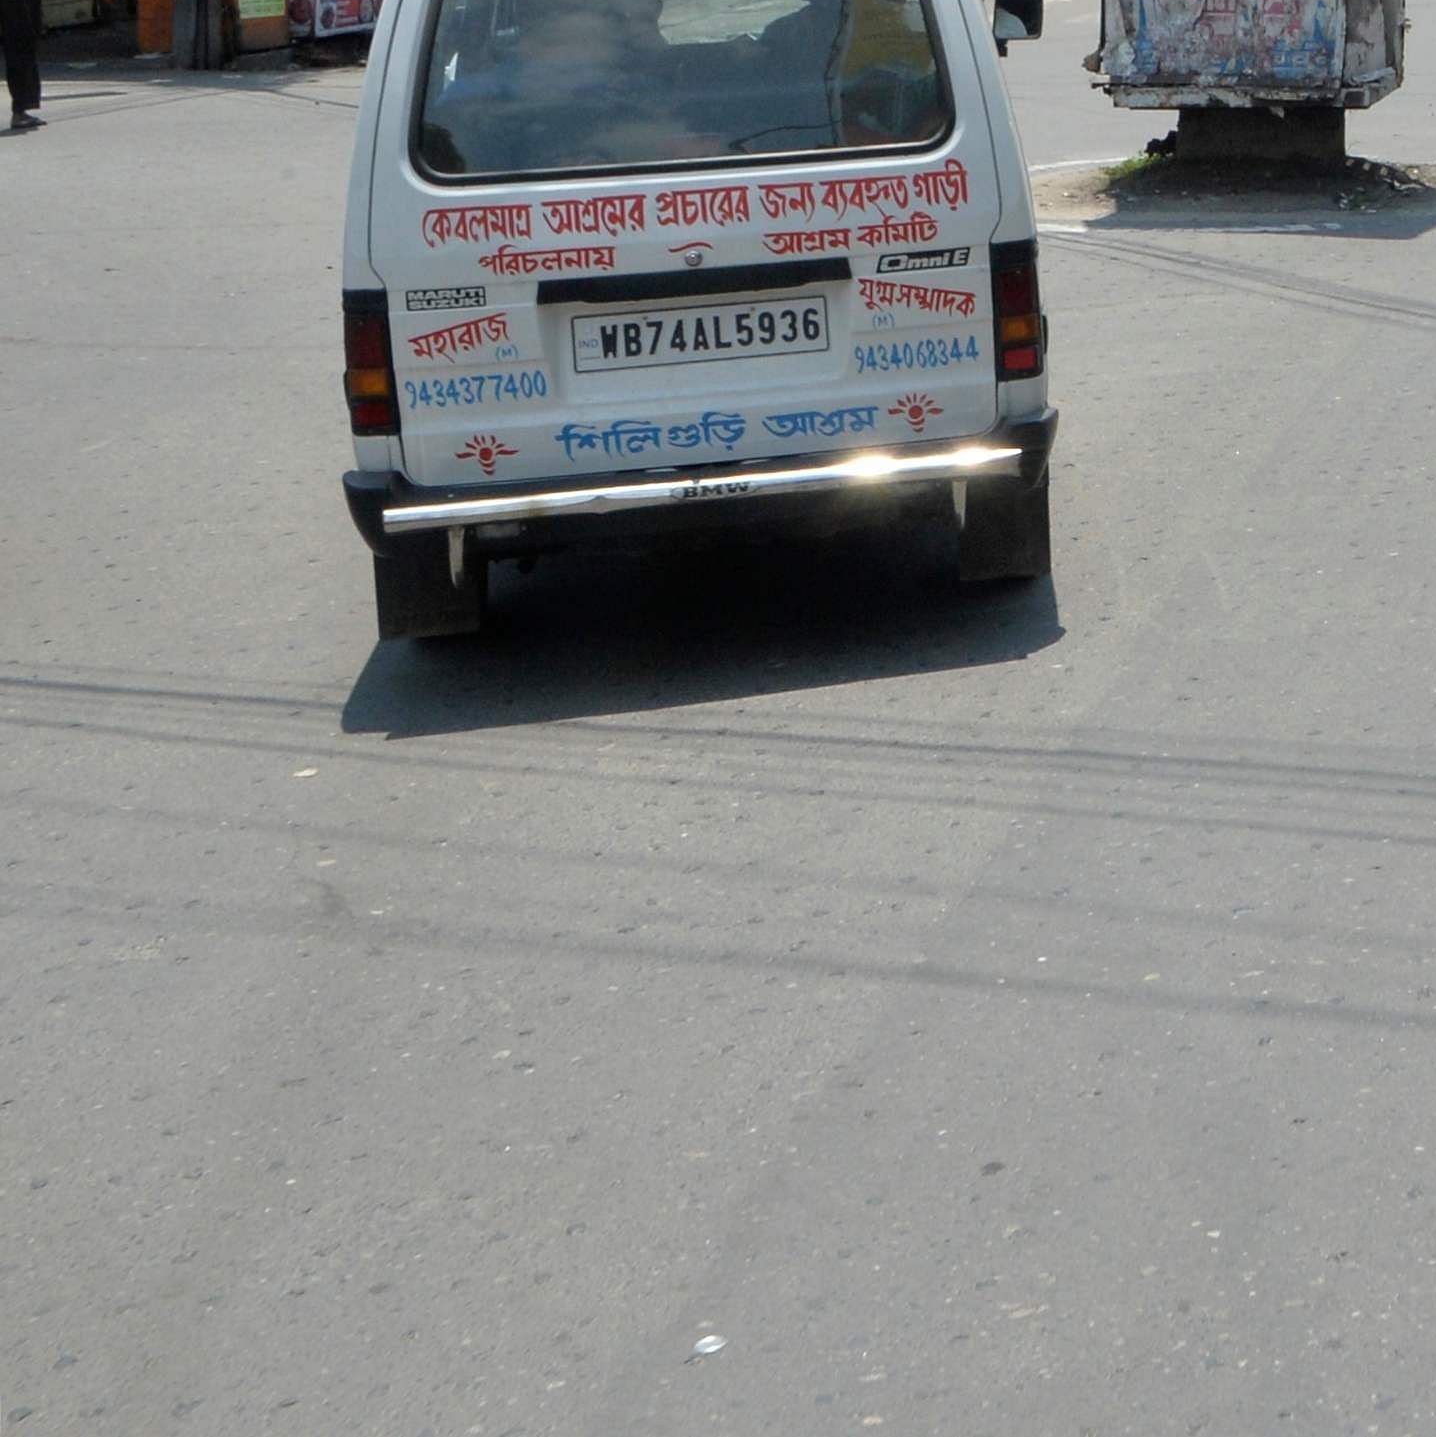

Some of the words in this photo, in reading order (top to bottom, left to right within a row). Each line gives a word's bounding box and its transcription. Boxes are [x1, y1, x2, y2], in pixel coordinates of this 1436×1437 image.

[422, 204, 533, 248] কেবলমাত্র
[541, 194, 647, 237] আশ্রমের
[655, 185, 750, 227] প্রচারের
[758, 181, 816, 222] জন্য
[762, 228, 851, 255] আশ্রম
[857, 211, 938, 248] কমিটি
[952, 248, 969, 264] E
[407, 288, 485, 301] MARUTI
[408, 299, 486, 311] SUZUKI
[408, 312, 509, 364] মহারাজ
[578, 339, 598, 349] IND
[601, 307, 820, 359] WB74AL5936
[854, 335, 980, 375] 9434068344
[405, 369, 548, 410] 9434377400
[554, 411, 746, 463] শিলিগুড়ি
[762, 405, 879, 439] আশ্রম
[682, 481, 751, 499] BMW
